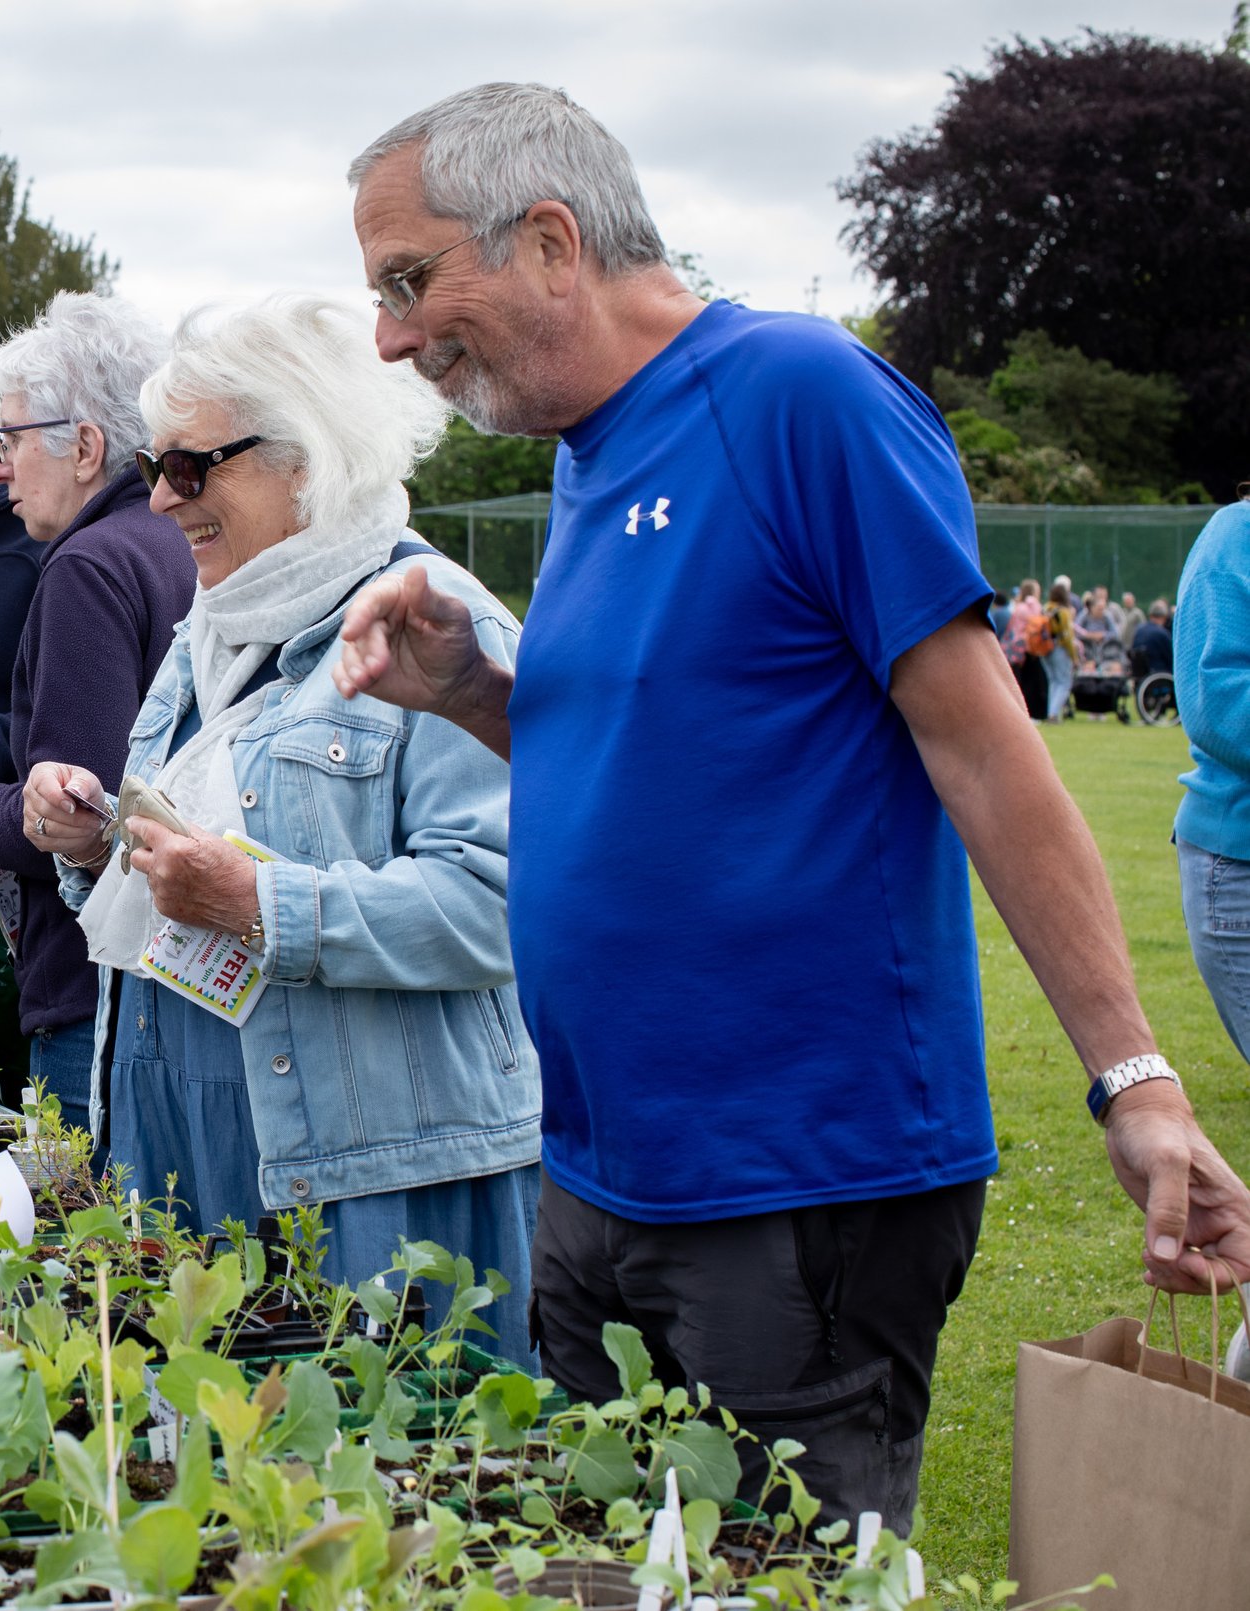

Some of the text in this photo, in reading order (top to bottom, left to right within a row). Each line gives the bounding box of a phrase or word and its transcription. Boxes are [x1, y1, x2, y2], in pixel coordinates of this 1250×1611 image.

[214, 943, 230, 964] 11am
[201, 966, 215, 983] 4pm
[212, 949, 249, 993] FETE
